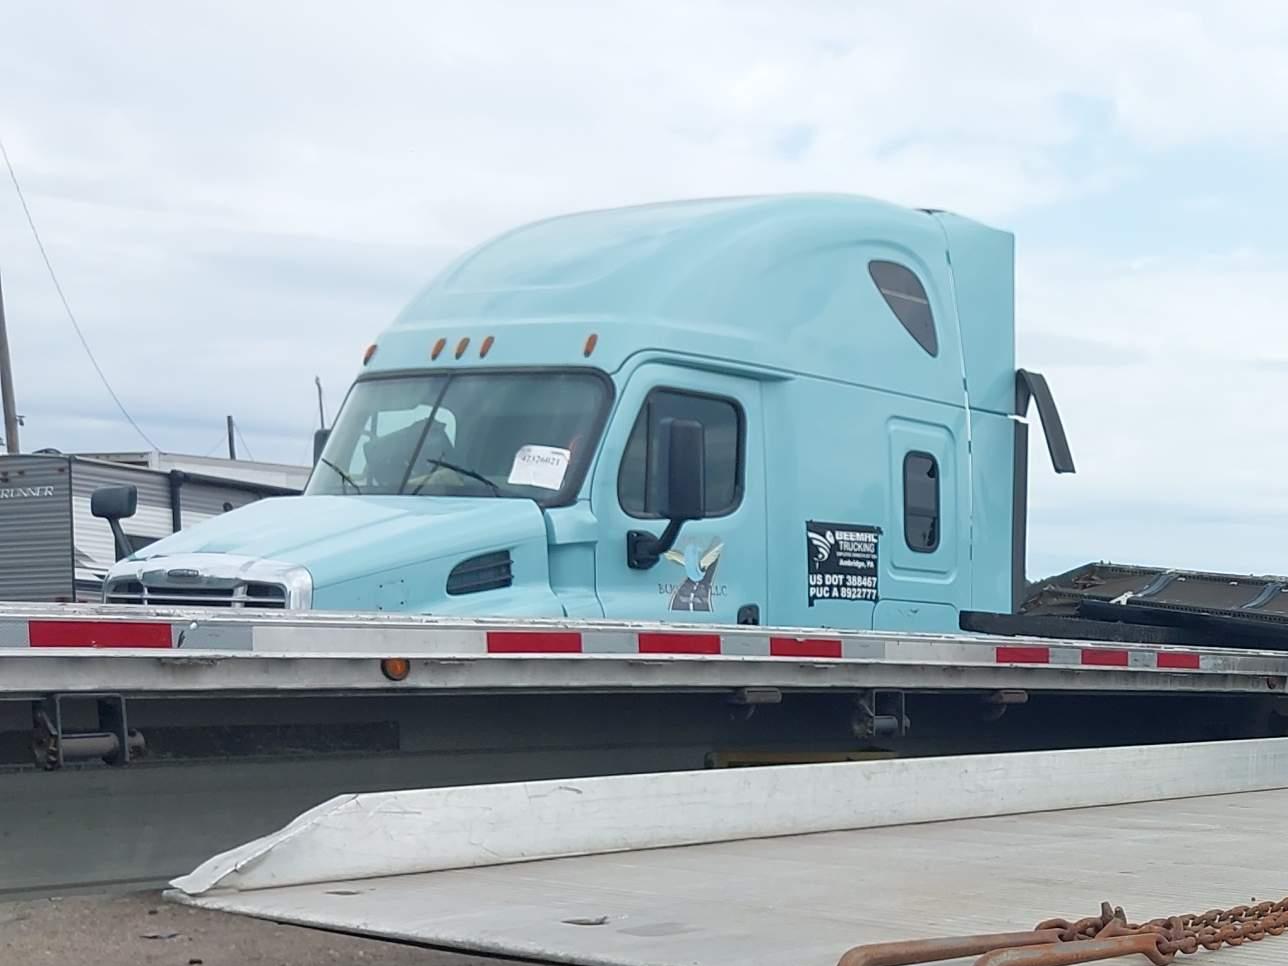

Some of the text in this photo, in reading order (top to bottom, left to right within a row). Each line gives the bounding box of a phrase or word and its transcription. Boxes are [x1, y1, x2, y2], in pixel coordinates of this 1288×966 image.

[839, 541, 875, 553] TRUCKING
[809, 574, 823, 585] US
[825, 574, 844, 586] DOT
[809, 586, 830, 598] PUC
[831, 587, 839, 598] A
